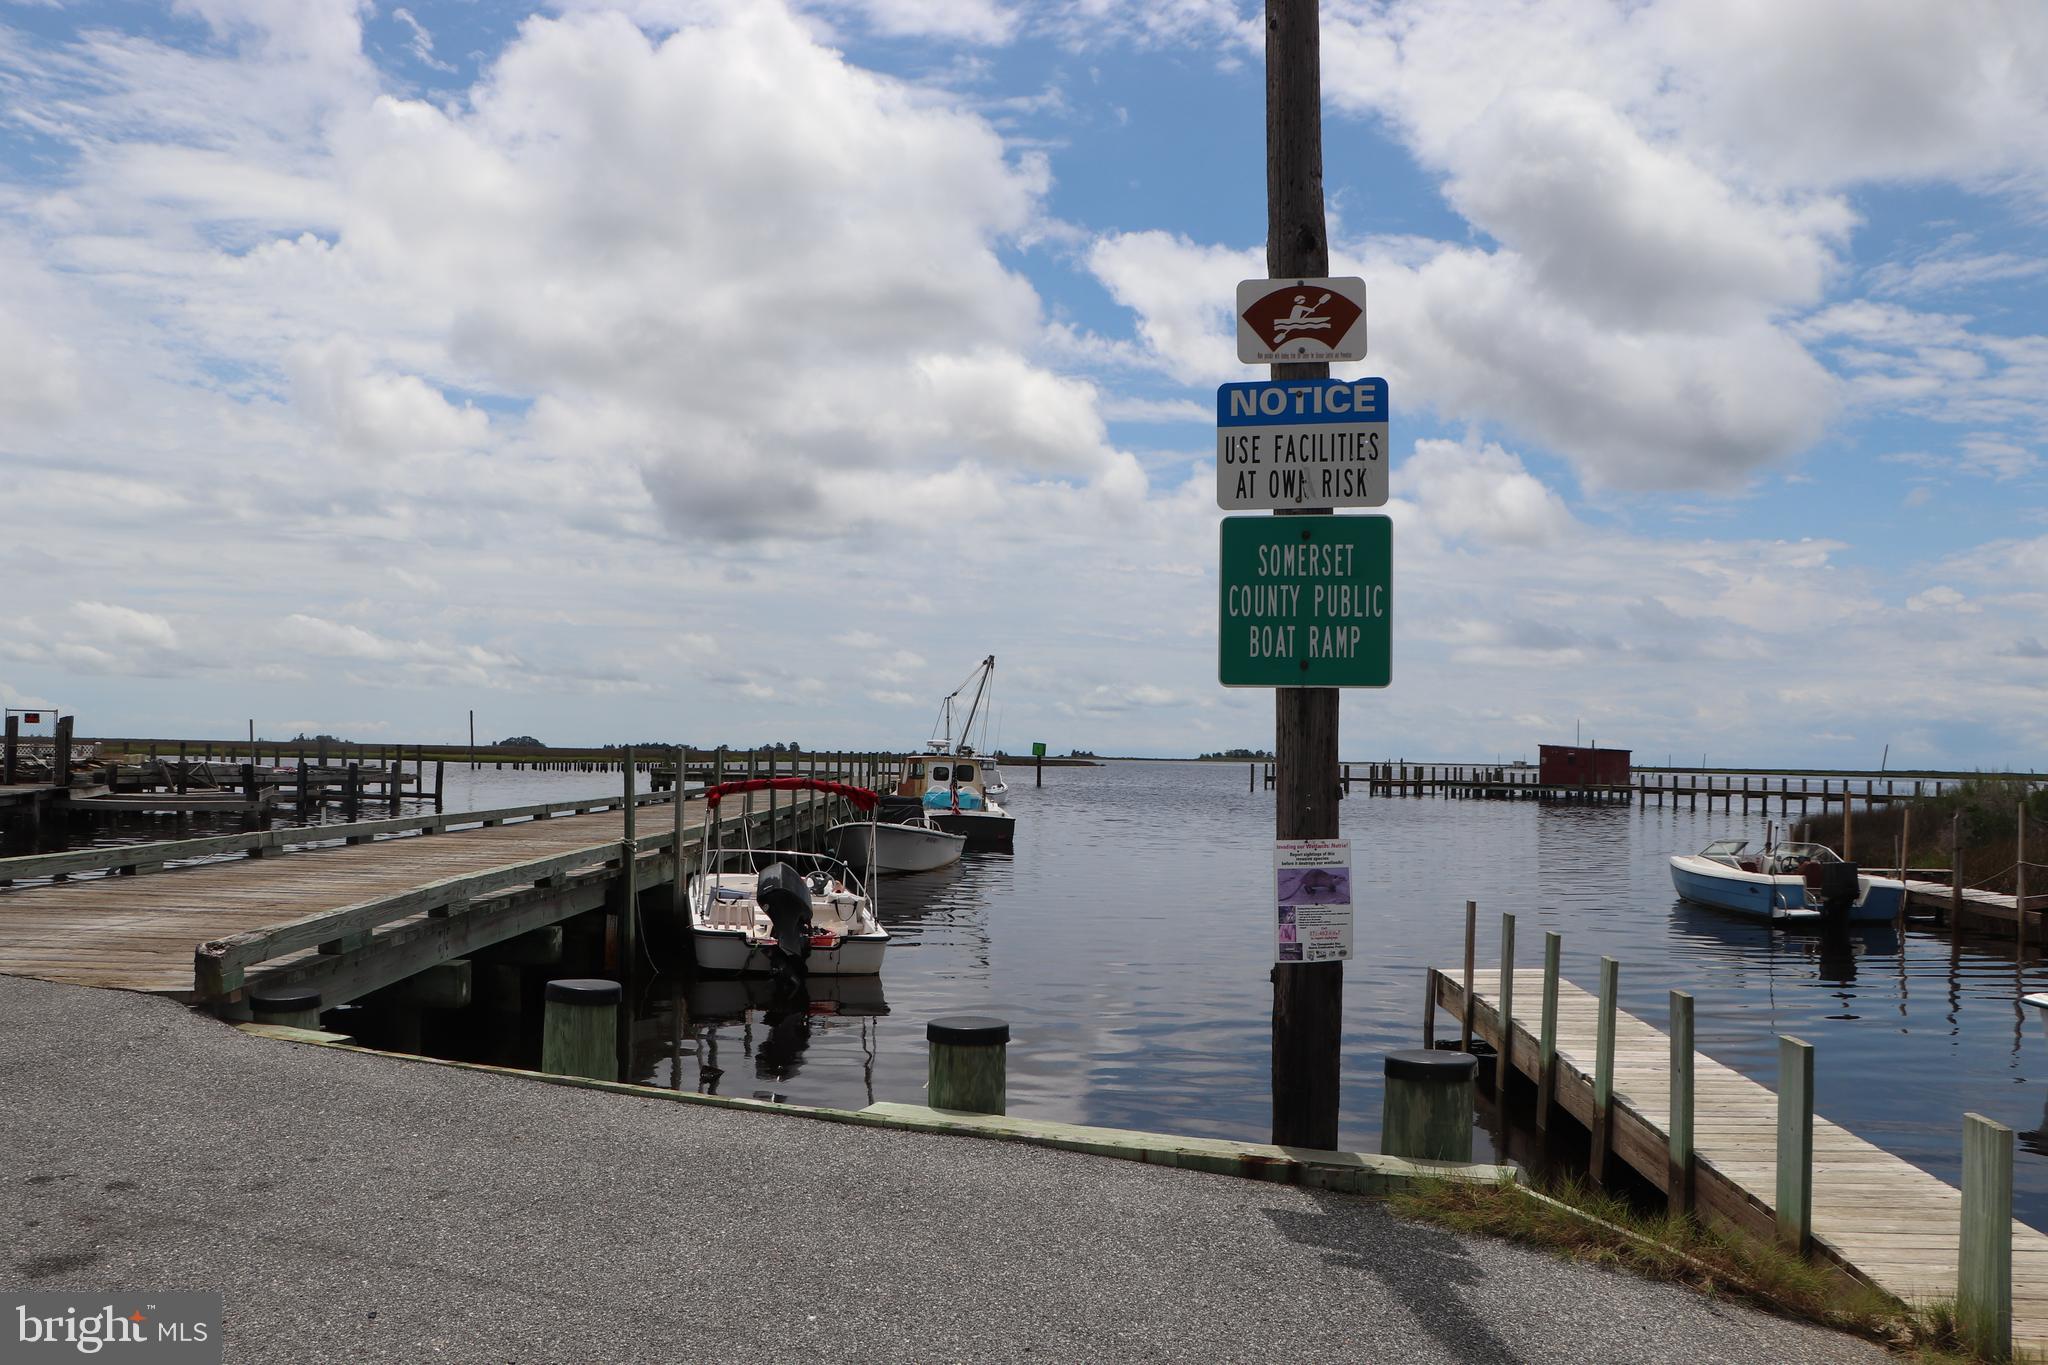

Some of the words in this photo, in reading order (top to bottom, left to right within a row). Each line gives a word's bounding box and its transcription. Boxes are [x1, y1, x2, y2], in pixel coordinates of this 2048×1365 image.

[1230, 384, 1376, 417] NOTICE
[1225, 435, 1261, 464] USE
[1274, 432, 1379, 463] FACILITIES
[1236, 470, 1256, 499] AT
[1322, 468, 1367, 497] RISK
[1258, 544, 1354, 577] SOMERSET
[1229, 585, 1300, 617] COUNTY
[1314, 585, 1383, 617] PUBLIC
[1250, 625, 1295, 658] BOAT
[1309, 625, 1361, 658] RAMP
